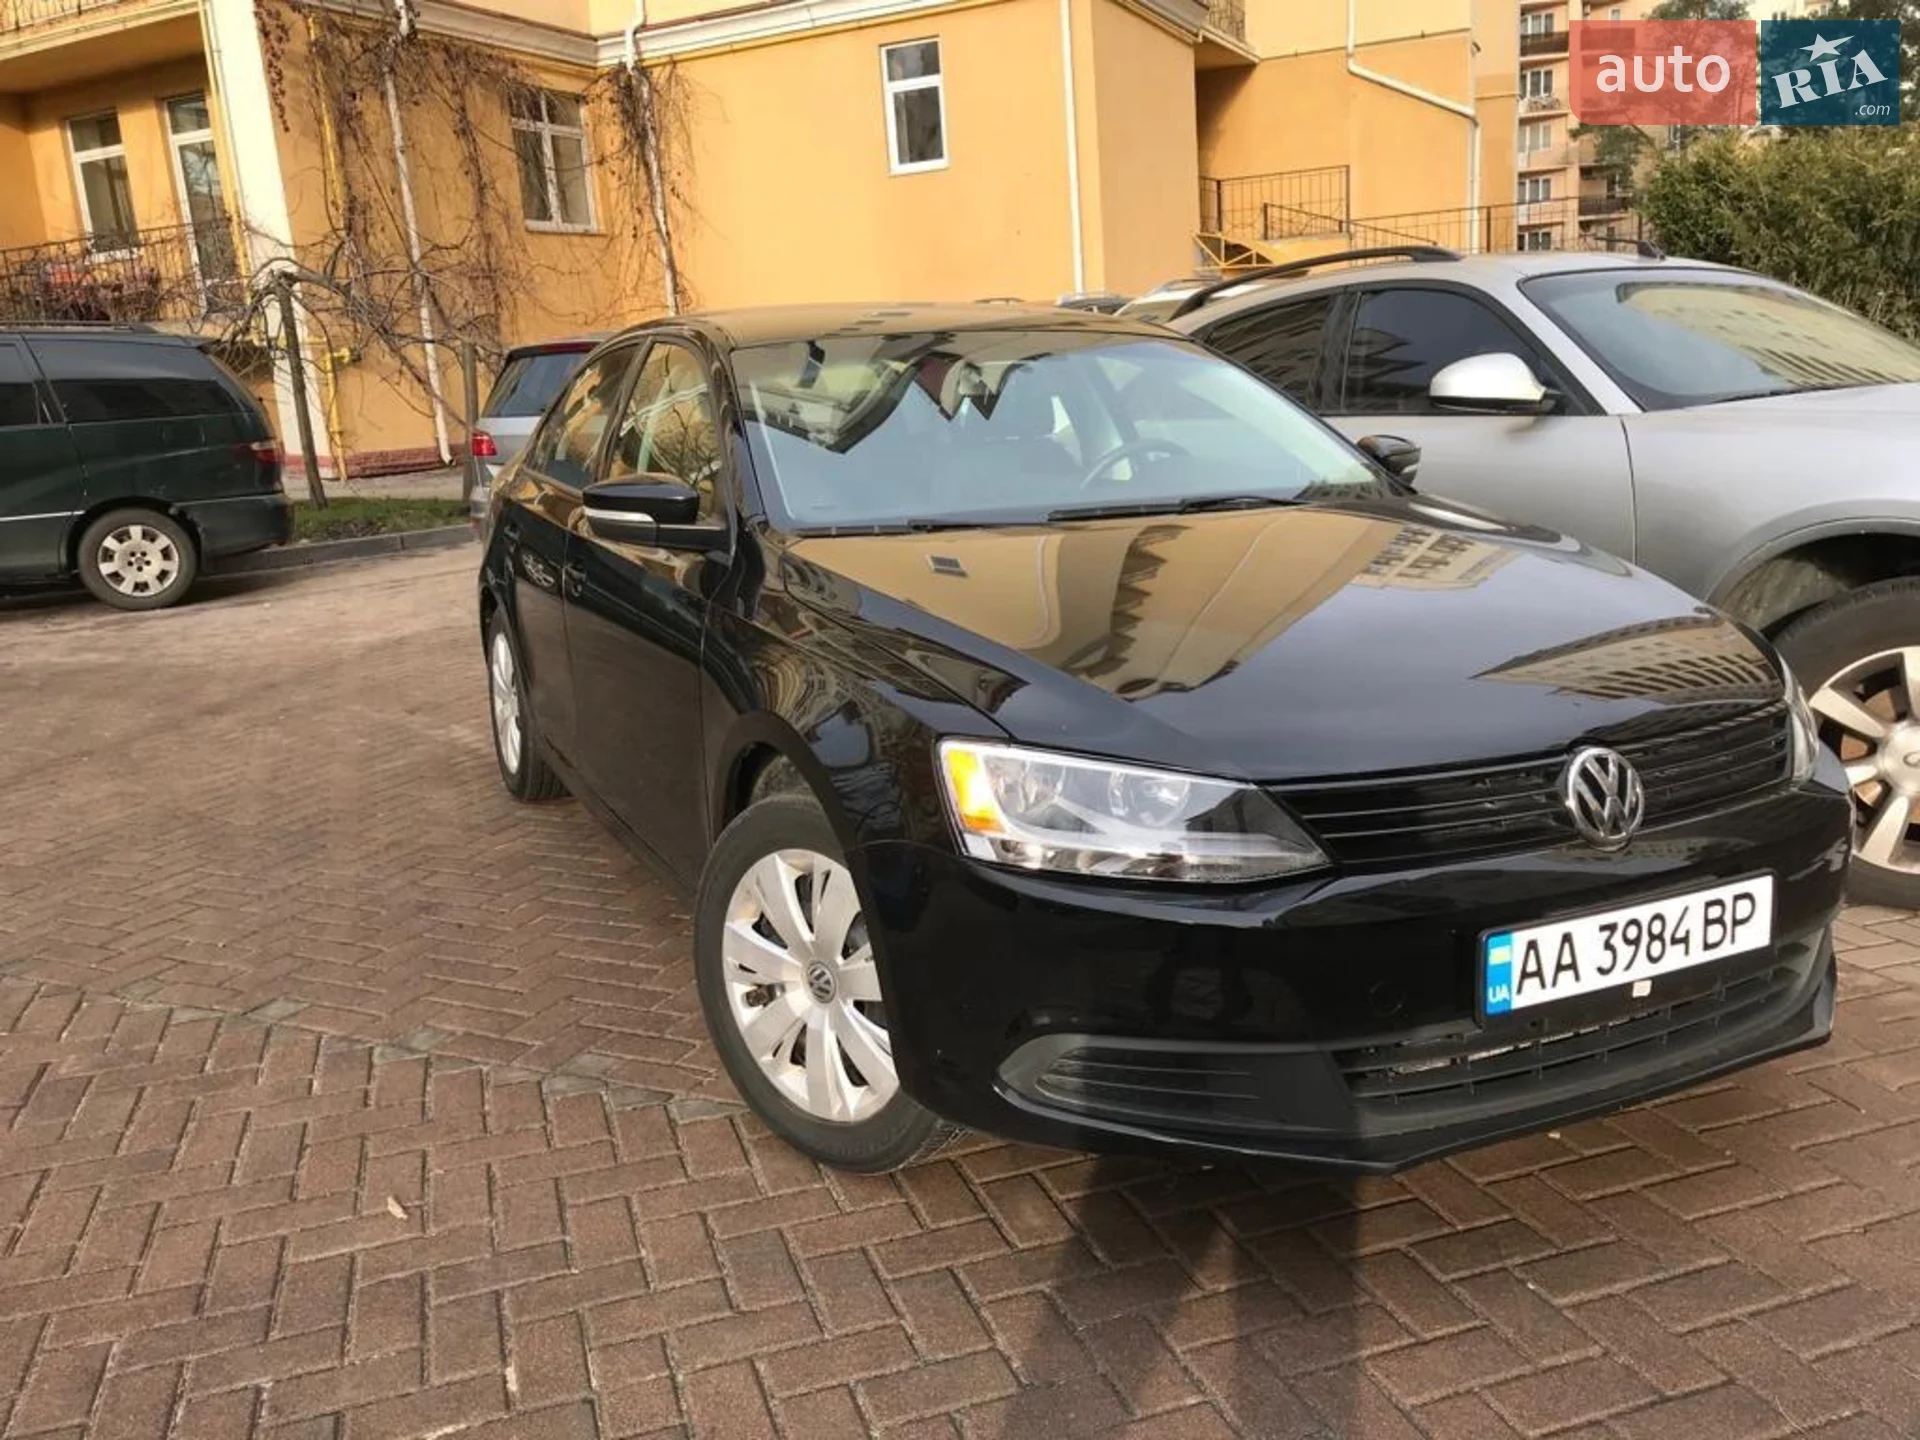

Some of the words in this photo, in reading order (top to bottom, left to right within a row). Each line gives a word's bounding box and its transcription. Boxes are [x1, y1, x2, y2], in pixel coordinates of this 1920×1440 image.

[1516, 932, 1580, 995] AA
[1596, 905, 1691, 976] 3984
[1702, 892, 1756, 951] BP
[1489, 985, 1510, 1003] UA
